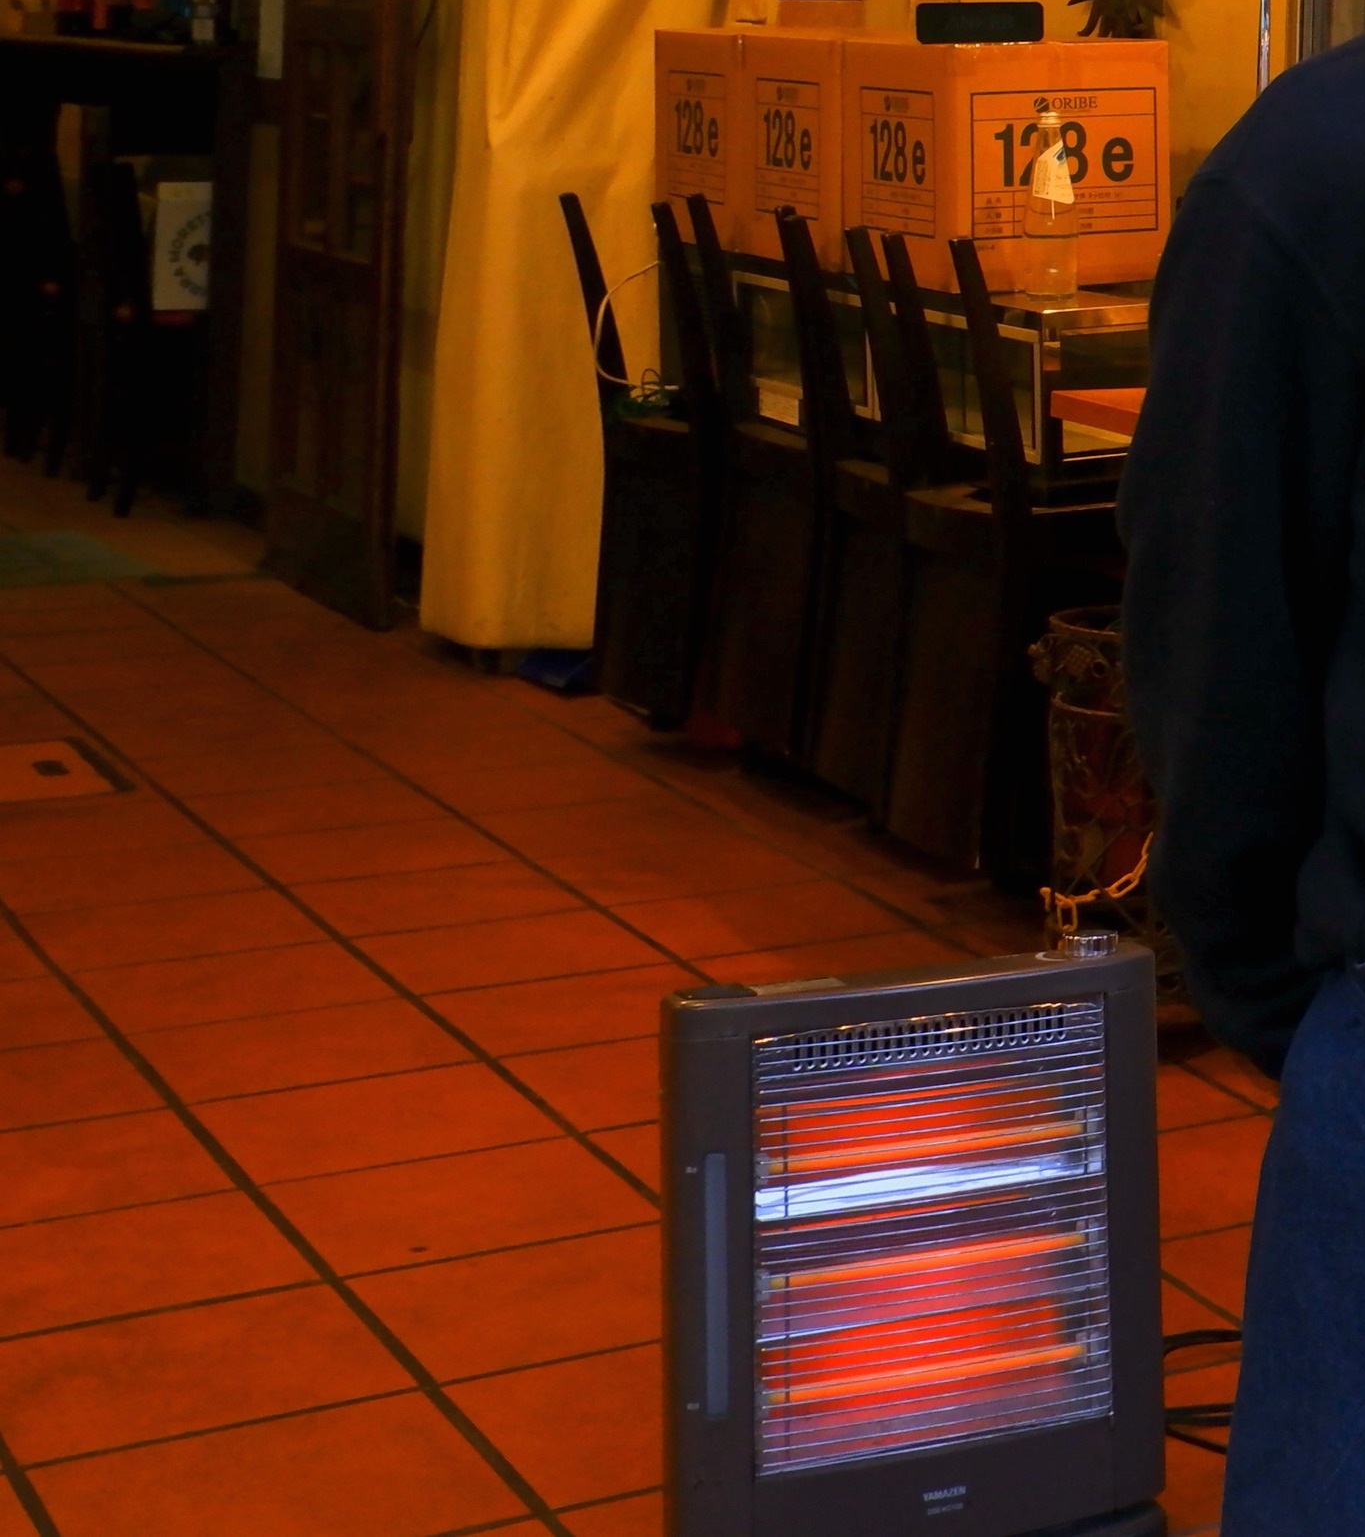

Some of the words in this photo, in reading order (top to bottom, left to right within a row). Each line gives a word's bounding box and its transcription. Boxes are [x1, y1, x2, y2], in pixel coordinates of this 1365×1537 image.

[674, 99, 704, 155] 128
[707, 117, 719, 157] e
[1051, 96, 1098, 110] ORIBE
[763, 108, 796, 168] 128
[799, 128, 812, 171] e
[870, 119, 908, 182] 128
[911, 139, 926, 185] e
[1102, 136, 1135, 182] e
